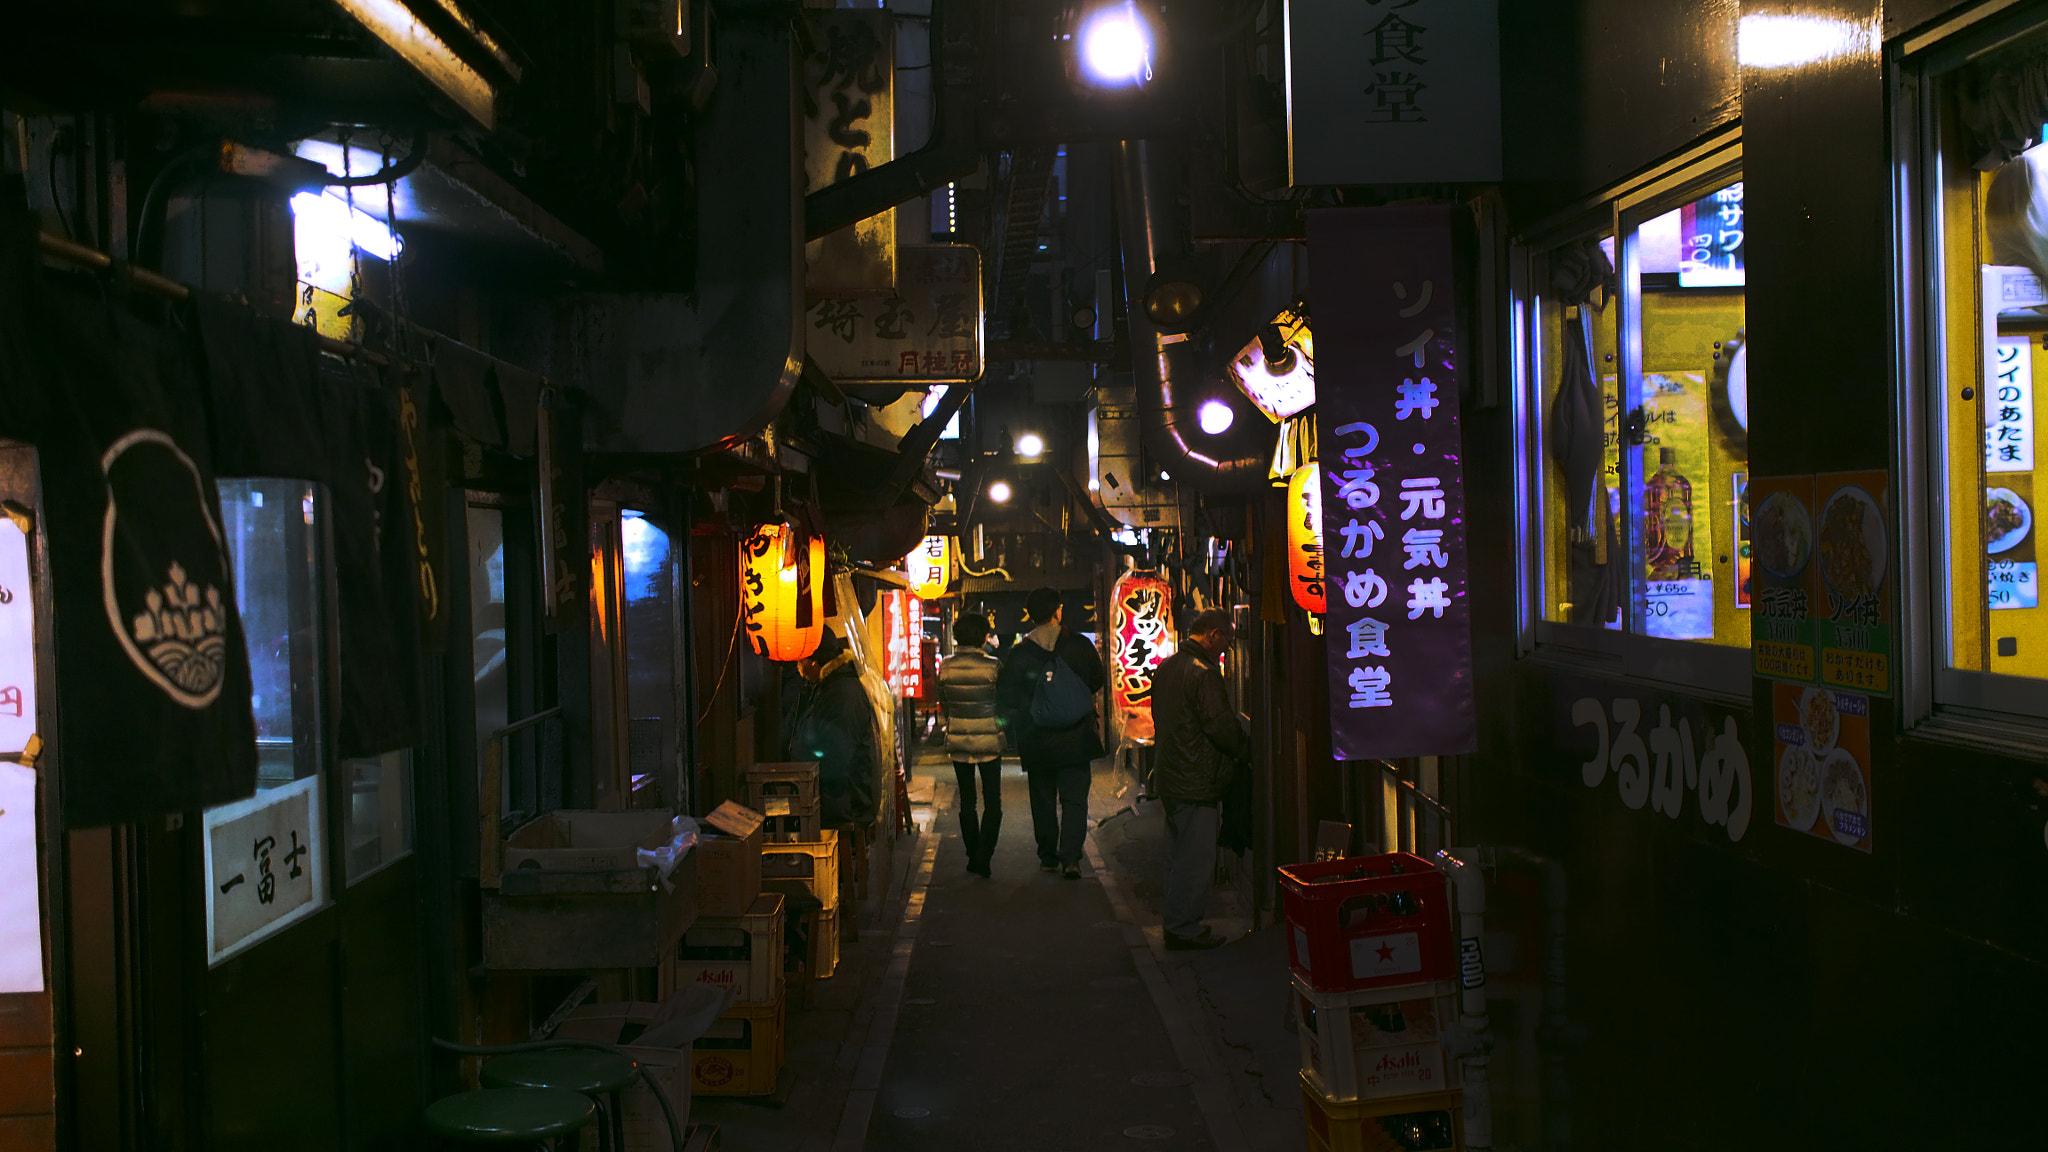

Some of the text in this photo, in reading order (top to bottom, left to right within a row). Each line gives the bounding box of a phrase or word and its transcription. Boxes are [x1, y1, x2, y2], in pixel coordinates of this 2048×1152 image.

[1363, 0, 1429, 123] 食堂
[899, 351, 973, 375] 月桂冠
[1997, 347, 2023, 462] ソイのあたま
[1392, 280, 1451, 620] ソイ丼・元気丼
[1334, 421, 1393, 709] つるかめ食堂
[1761, 588, 1808, 621] 元気丼
[1828, 592, 1880, 628] ソイ丼
[1572, 697, 1752, 842] つるかめ
[696, 969, 734, 983] Asahi
[1375, 1050, 1421, 1072] Asahi
[1418, 1068, 1432, 1081] 20
